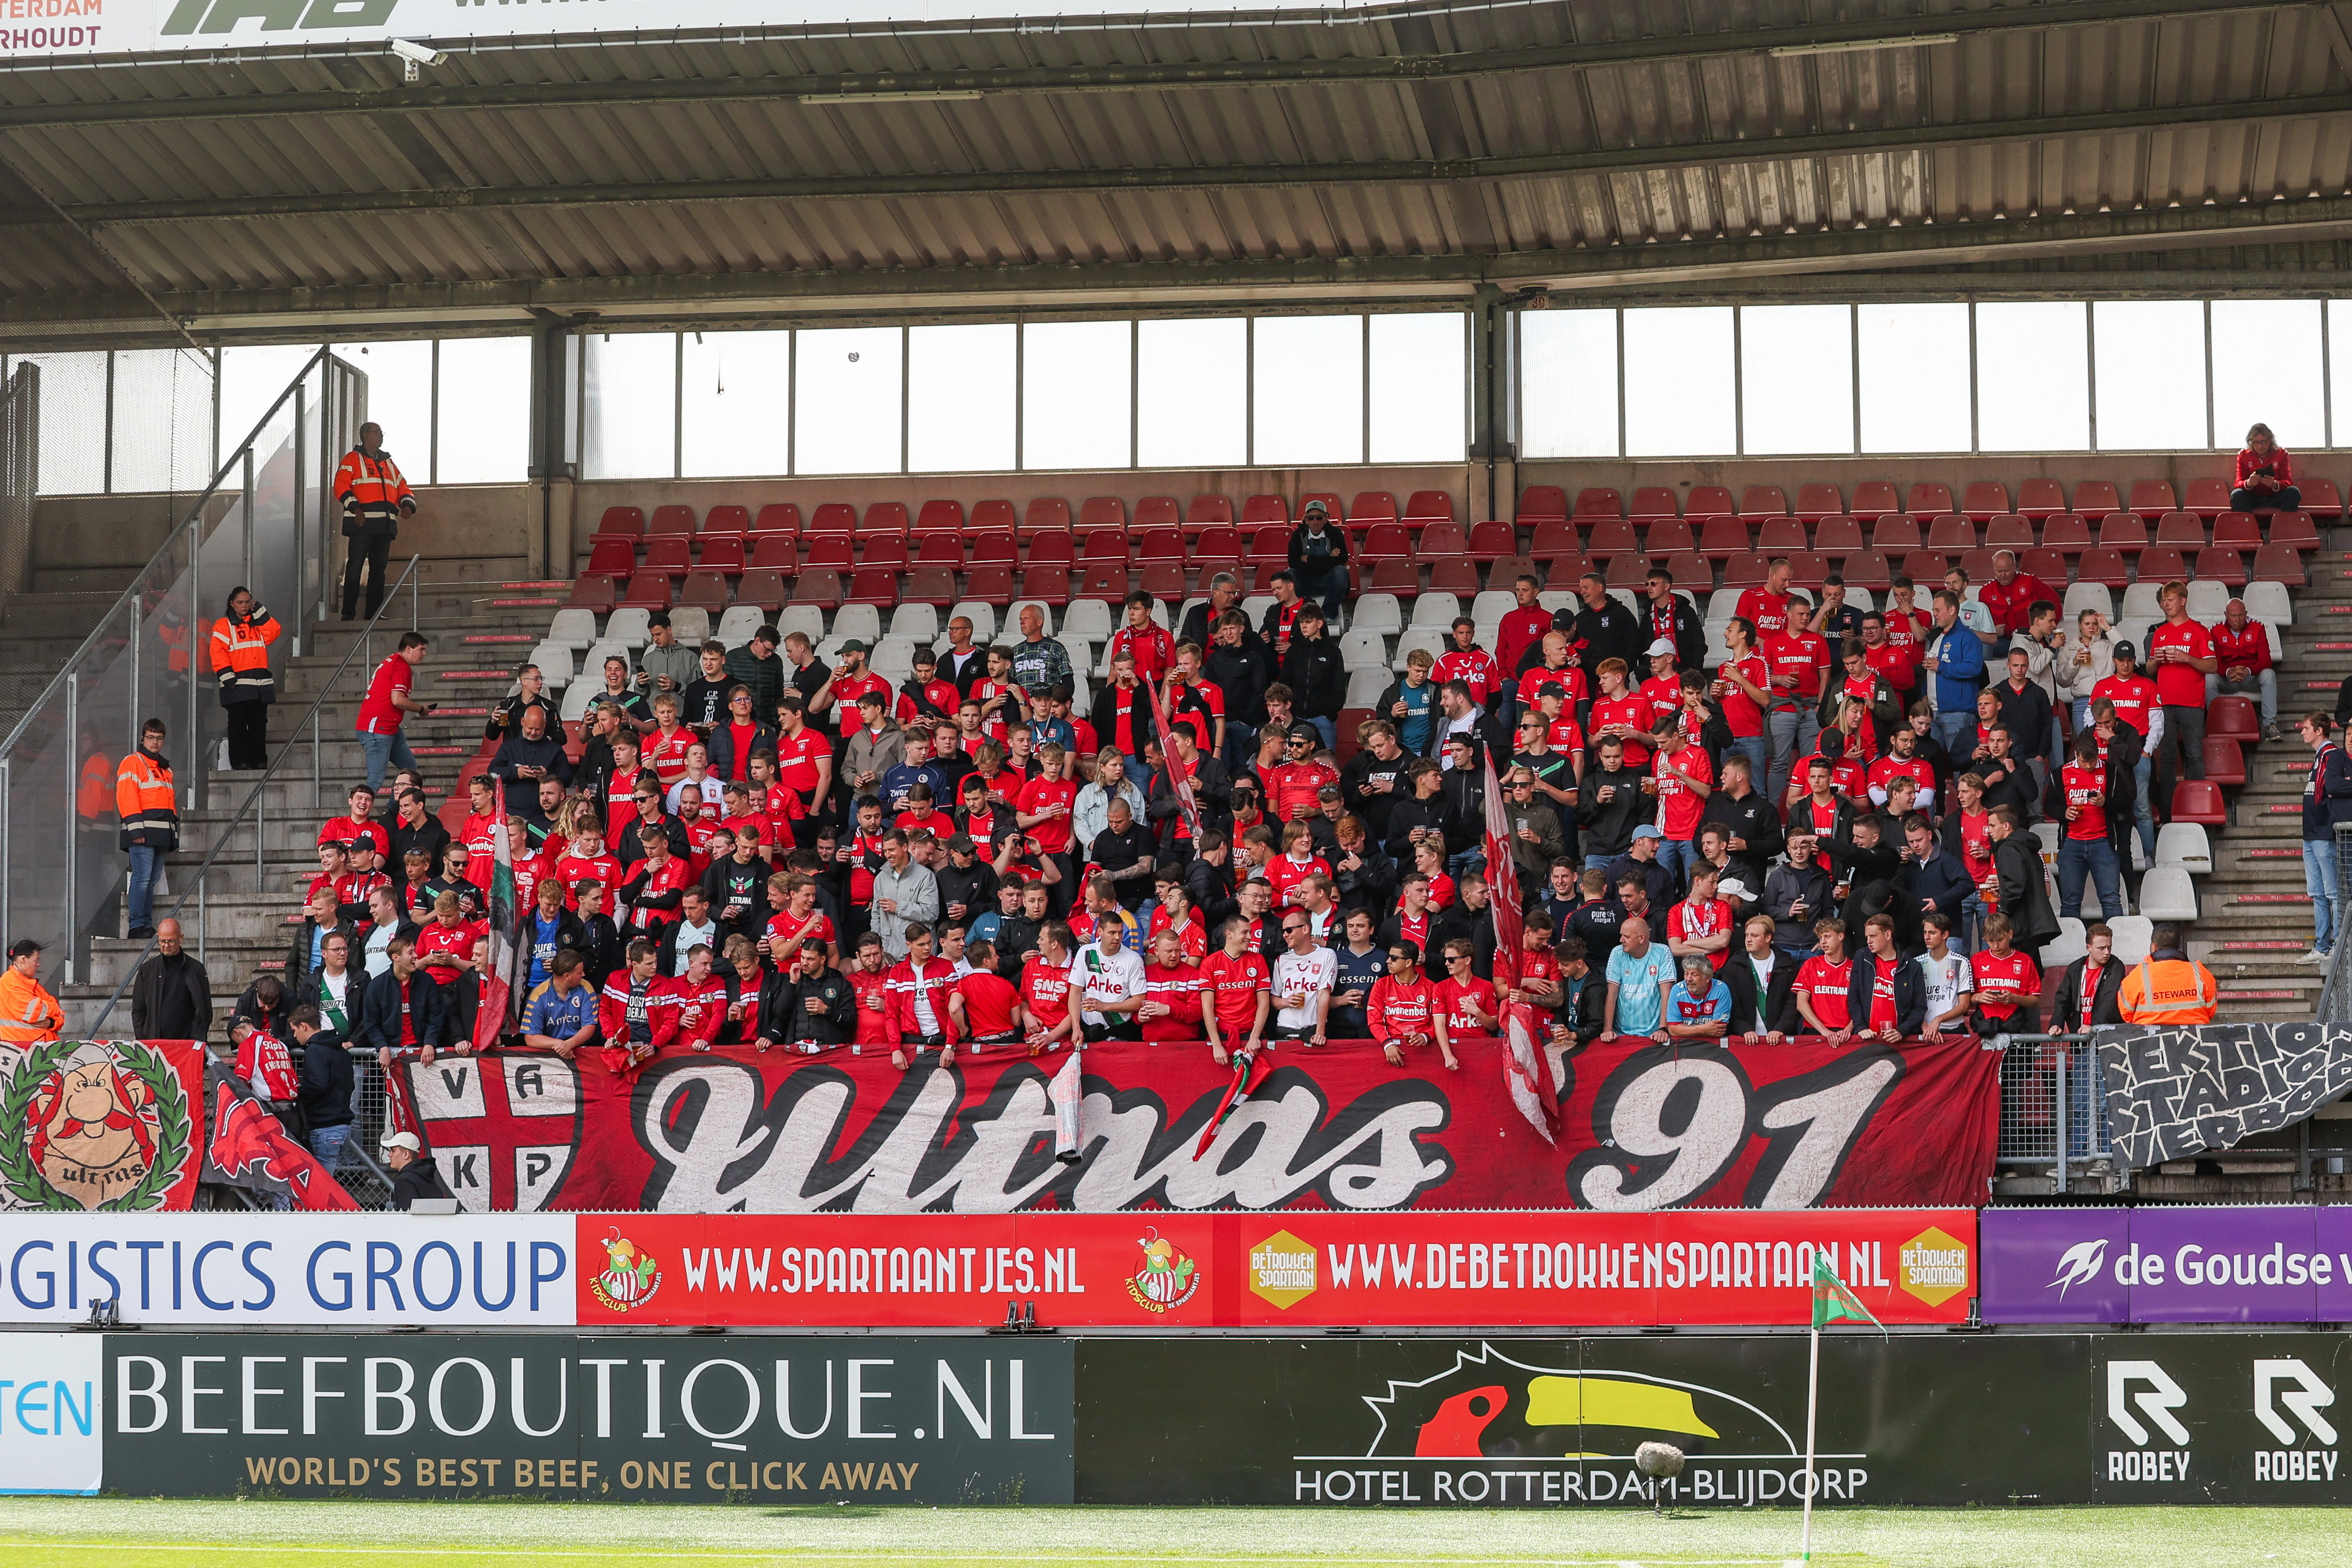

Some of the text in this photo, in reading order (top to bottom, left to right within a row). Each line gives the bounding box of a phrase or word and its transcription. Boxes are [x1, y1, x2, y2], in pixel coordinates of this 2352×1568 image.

[1758, 615, 1777, 625] pure
[1015, 659, 1043, 673] SNS
[1453, 670, 1485, 684] Arke
[1658, 779, 1674, 790] pure
[2069, 788, 2089, 798] pure
[523, 885, 533, 910] bank
[1592, 910, 1606, 920] pure
[1033, 978, 1066, 994] SNS
[1086, 974, 1123, 994] Arke
[1218, 979, 1256, 990] essent
[1284, 977, 1318, 992] Arke
[1624, 983, 1643, 994] pure
[1814, 985, 1848, 995] ELEKTRAM
[1926, 985, 1940, 994] ure
[1980, 977, 2021, 989] ELEKTRAMAT
[1035, 990, 1059, 1002] bank
[2153, 989, 2197, 1000] STEWARD
[440, 1065, 543, 1099] V A
[63, 1163, 145, 1185] ultras
[453, 1153, 552, 1189] K P
[1253, 1252, 1314, 1270] BETROKKEN
[1327, 1241, 1889, 1289] WWW.DEBETROKKENSPARTAAN.NL
[1903, 1249, 1965, 1267] BETROKKEN
[2114, 1242, 2165, 1286] de
[2174, 1242, 2332, 1286] Goudse
[0, 1240, 566, 1312] GISTICS GROUP
[682, 1247, 1085, 1293] WWW.SPARTAANTJES.NL
[1259, 1270, 1314, 1287] SPARTAAN
[1909, 1266, 1965, 1284] SPARTAAN
[589, 1277, 628, 1313] KIDSCLUB
[638, 1272, 662, 1305] SPARTAANTJES
[1125, 1277, 1165, 1314] KIDSCLUB
[1176, 1272, 1200, 1307] SPARTAANTJES
[117, 1355, 1055, 1452] BEEFBOUTIQUE.NL
[246, 1457, 920, 1492] WORLD'S BEST BEEF, ONE CLICK AWAY
[2108, 1451, 2191, 1482] ROBEY
[2255, 1451, 2338, 1482] ROBEY
[1295, 1470, 1421, 1501] HOTEL
